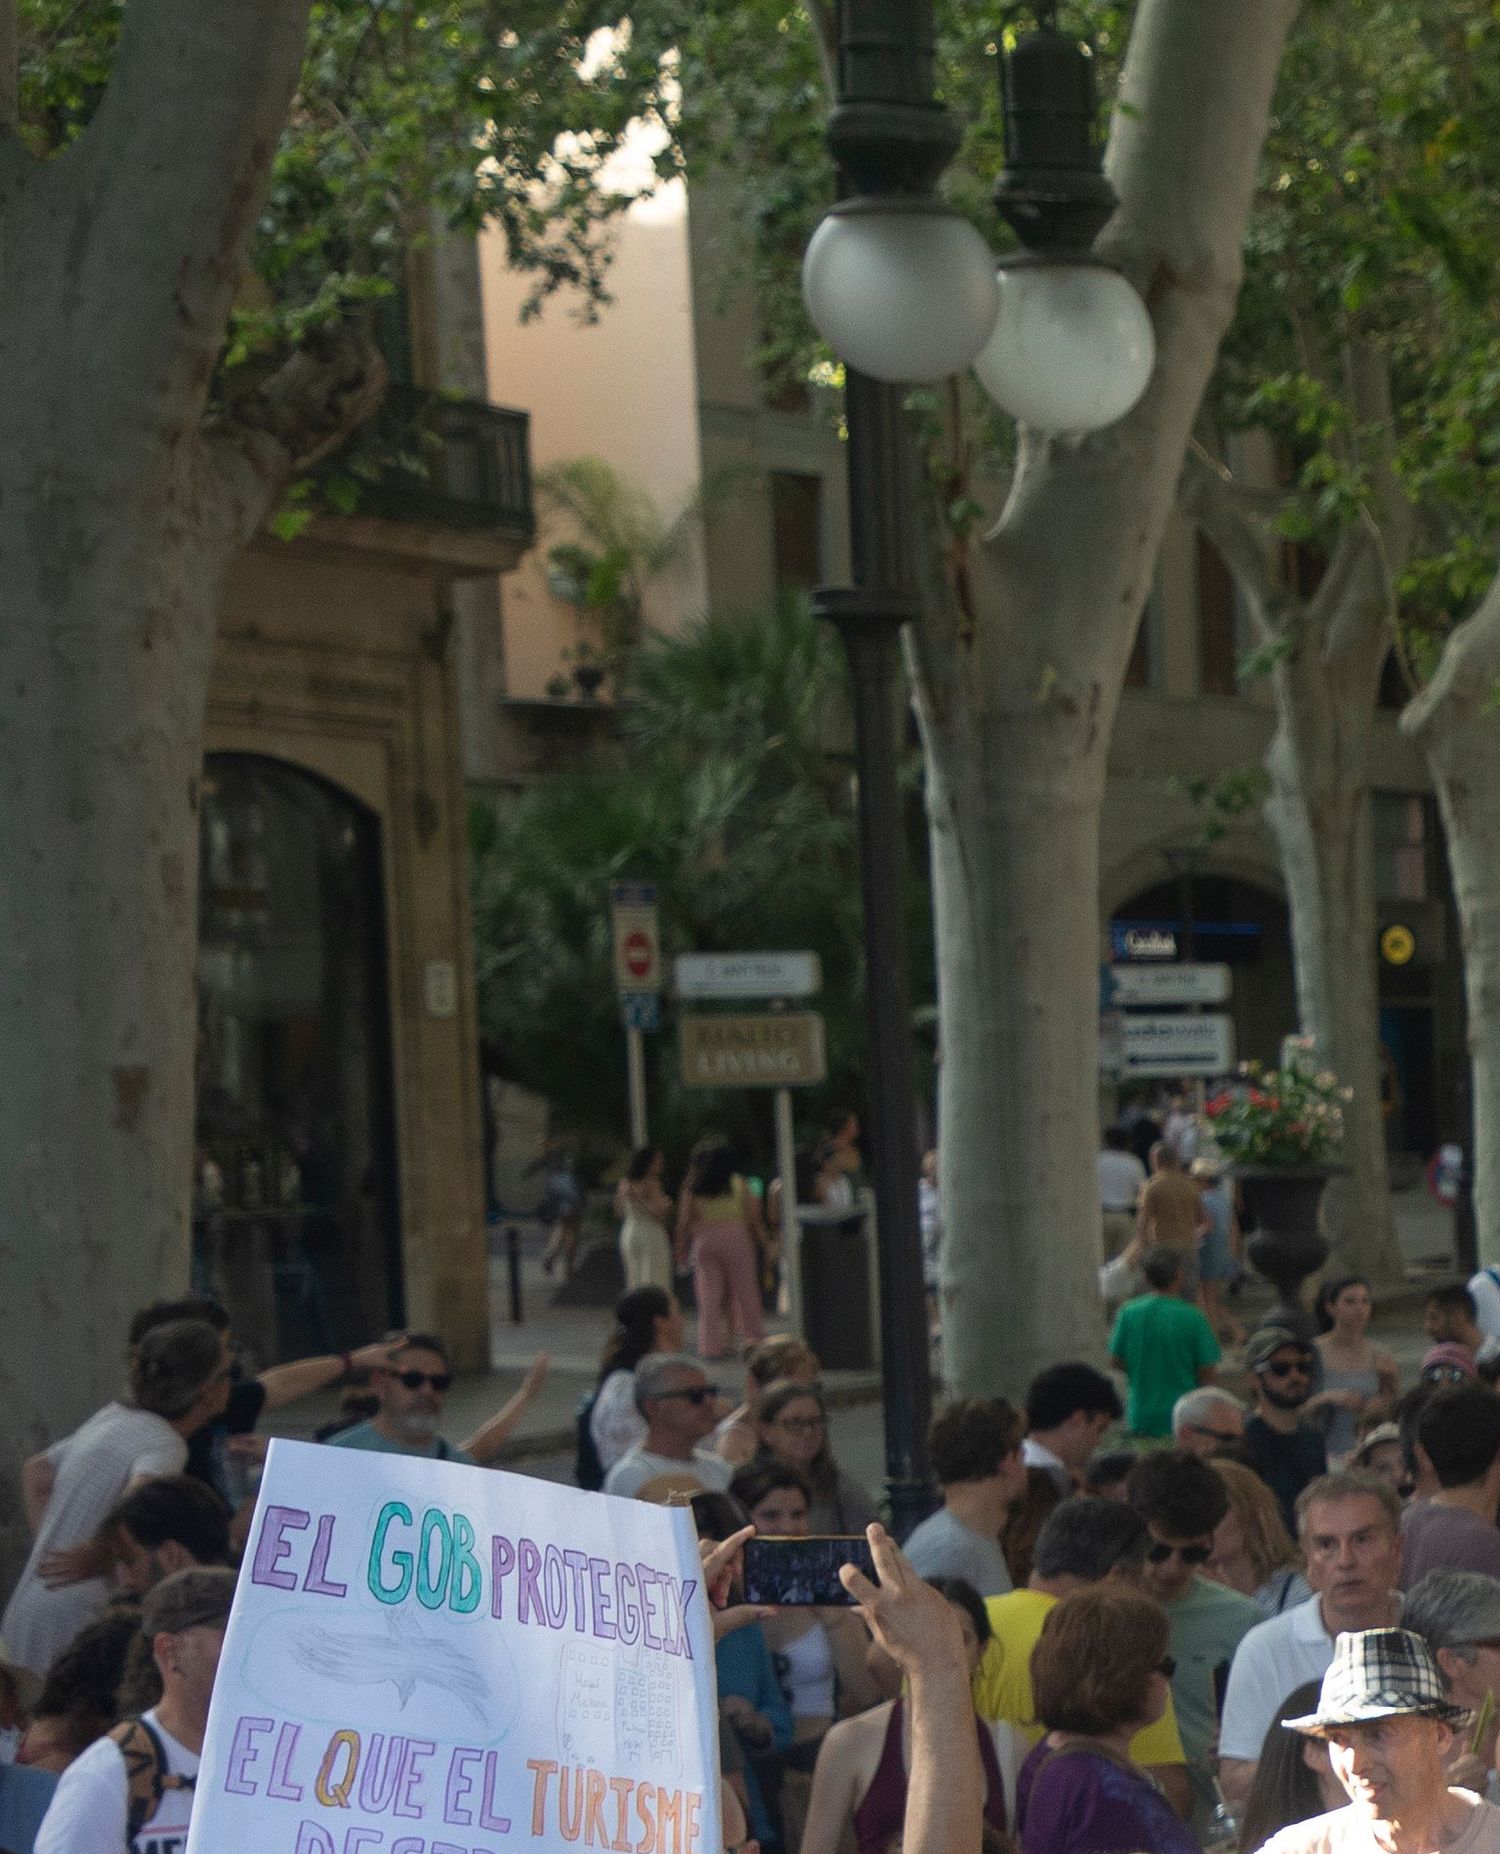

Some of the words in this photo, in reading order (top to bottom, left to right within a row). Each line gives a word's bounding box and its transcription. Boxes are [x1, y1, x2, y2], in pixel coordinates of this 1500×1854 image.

[252, 1505, 347, 1599] EL
[367, 1501, 483, 1614] GOB
[491, 1535, 697, 1661] PROTEGEIX
[224, 1716, 304, 1802] EL
[315, 1729, 436, 1820] QUE
[443, 1747, 512, 1834] EL
